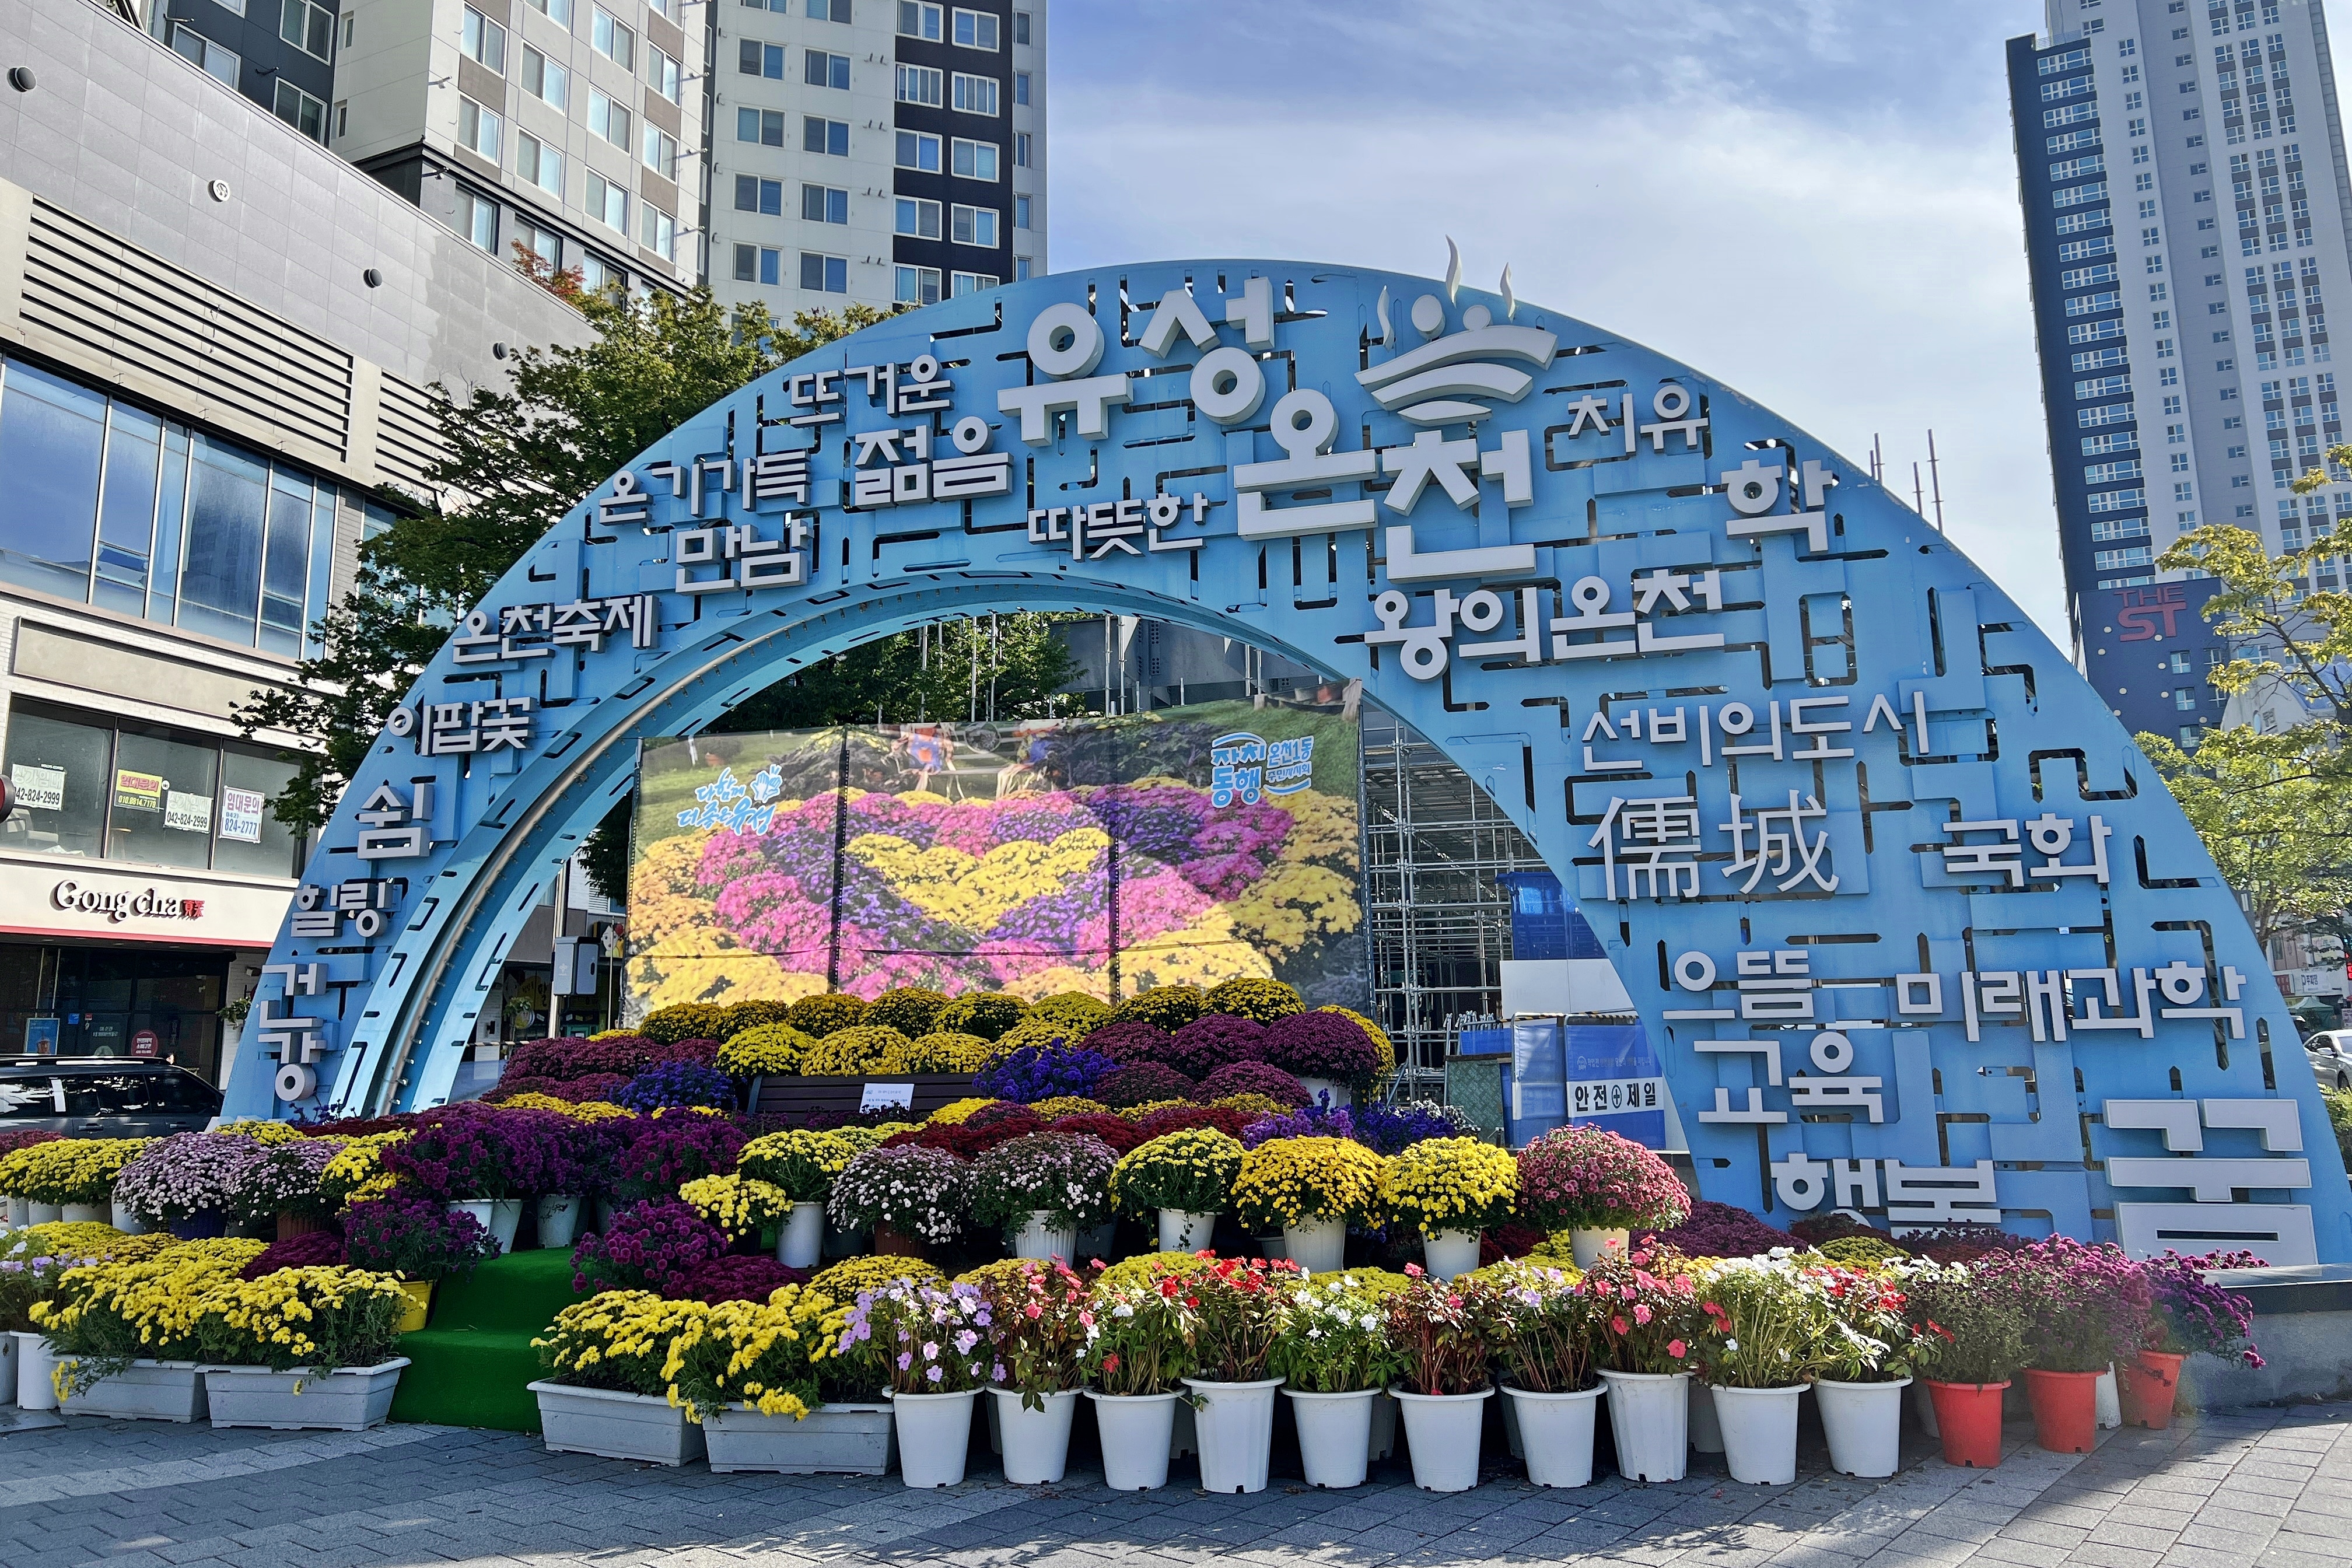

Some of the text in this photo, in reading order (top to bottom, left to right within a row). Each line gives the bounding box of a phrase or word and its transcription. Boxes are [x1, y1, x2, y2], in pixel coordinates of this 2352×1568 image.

[790, 355, 955, 427] 뜨거운
[1568, 384, 1708, 455] 치유
[599, 450, 811, 526] 온기가득
[855, 416, 1013, 510] 젊음
[1028, 492, 1211, 563] 따뜻한
[1721, 459, 1838, 553] 학
[676, 519, 814, 596] 만남
[452, 595, 658, 664] 온천축제
[1364, 569, 1725, 682] 왕의온천
[2113, 585, 2185, 608] THE
[2118, 601, 2186, 642] ST
[388, 697, 534, 757] 이팝꽃
[1212, 744, 1265, 765] 자치
[1269, 737, 1312, 766] 온천1동
[1583, 691, 1930, 771] 선비의도시
[14, 787, 60, 805] 42-824-2999
[120, 775, 159, 792] 임대문의
[227, 792, 260, 815] 임대문의
[696, 767, 746, 802] 다함께
[1212, 767, 1261, 806] 동행
[167, 811, 208, 828] 042-824-2999
[225, 818, 257, 835] 824-2777
[357, 783, 435, 860] 쉼
[1587, 789, 1840, 901] 儒城
[1942, 813, 2112, 886] 국화
[57, 879, 181, 922] Gong cha
[290, 881, 394, 938] 힐링
[1662, 949, 1815, 1021] 으뜸
[1895, 960, 2247, 1043] 미래과학
[258, 963, 327, 1101] 건강
[1575, 1082, 1656, 1112] 안전 제일
[1693, 1031, 1882, 1124] 교육
[2103, 1098, 2318, 1267] 꿈
